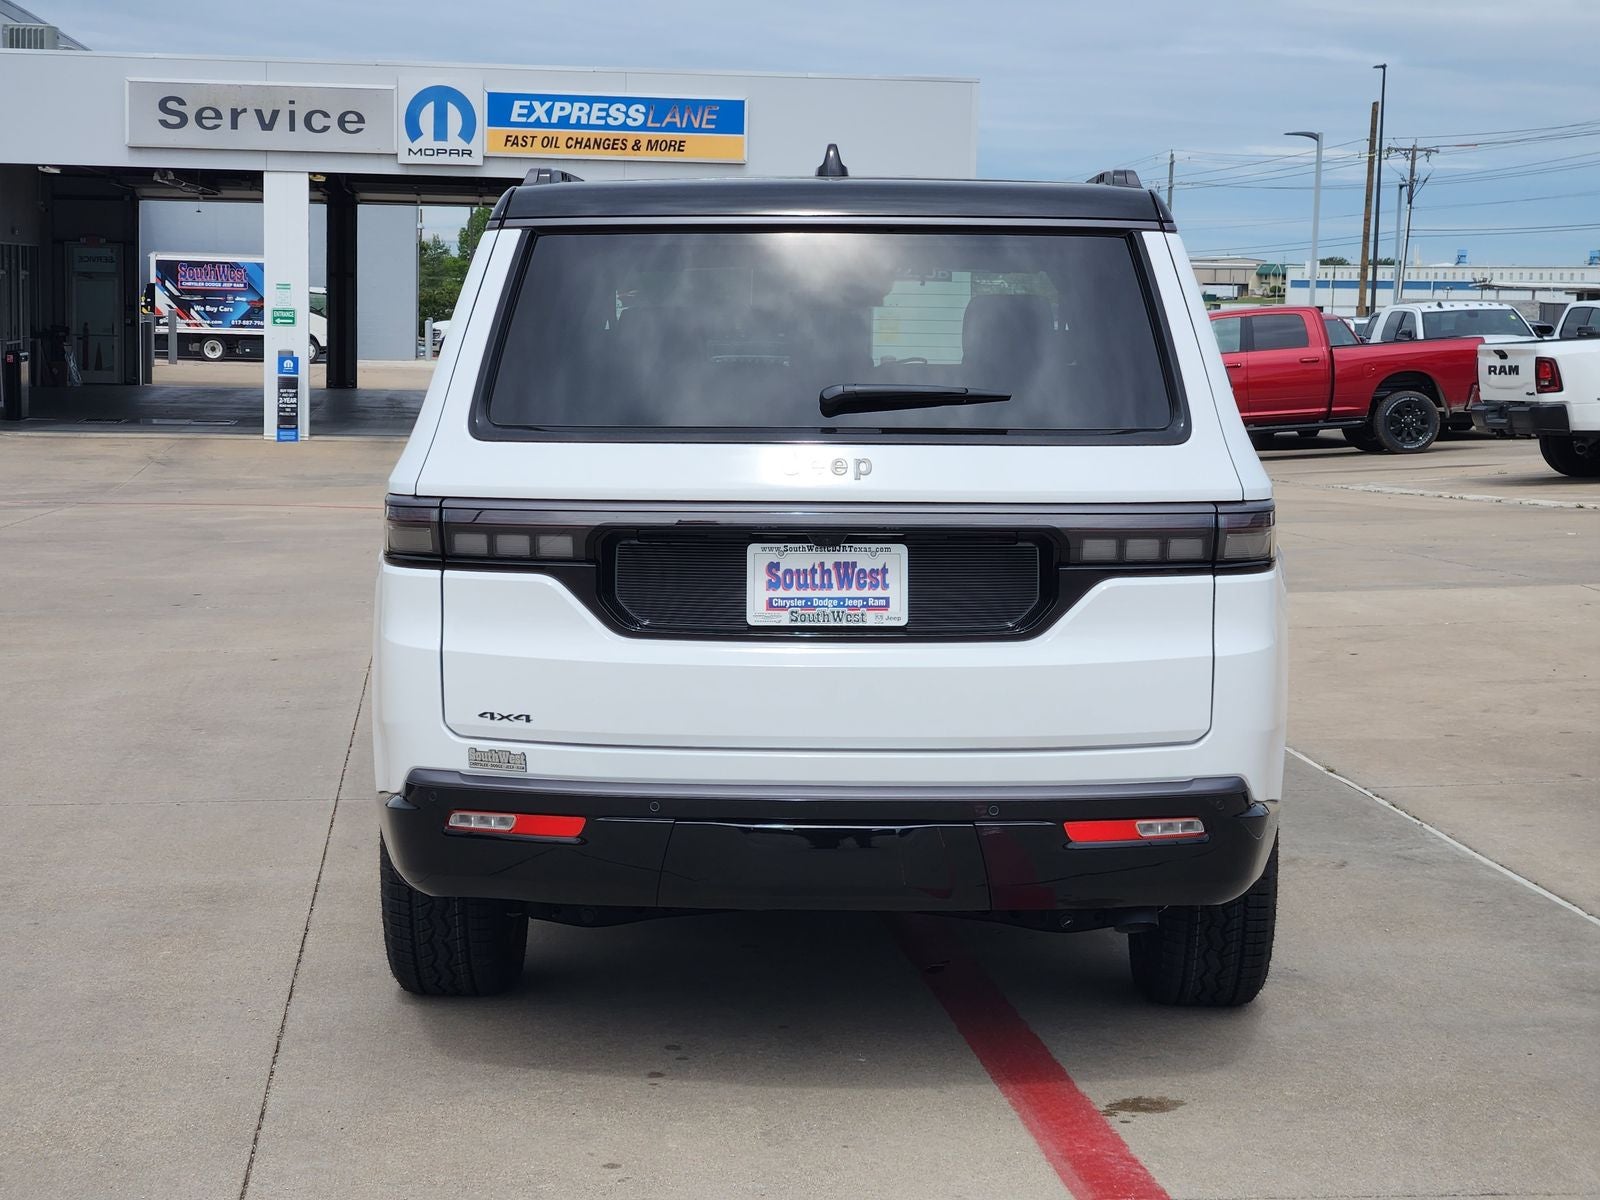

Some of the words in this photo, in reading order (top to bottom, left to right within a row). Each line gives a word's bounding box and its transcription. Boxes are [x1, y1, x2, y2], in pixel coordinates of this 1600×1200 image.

[158, 95, 366, 134] Service
[504, 134, 537, 149] FAST
[541, 135, 561, 149] OIL
[564, 137, 628, 151] CHANGES
[631, 139, 642, 152] &
[645, 139, 686, 152] MORE
[408, 147, 473, 158] MOPAR
[178, 262, 248, 282] SouthWest
[194, 304, 205, 312] We
[206, 305, 218, 313] Buy
[1488, 365, 1520, 376] RAM
[765, 561, 890, 592] SouthWest
[772, 598, 806, 608] Chrysler
[813, 598, 838, 608] Dodge
[844, 599, 863, 608] Jeep
[868, 598, 886, 607] Ram
[789, 609, 867, 624] SouthWest
[478, 711, 533, 723] 4x4
[468, 747, 527, 764] SouthWest
